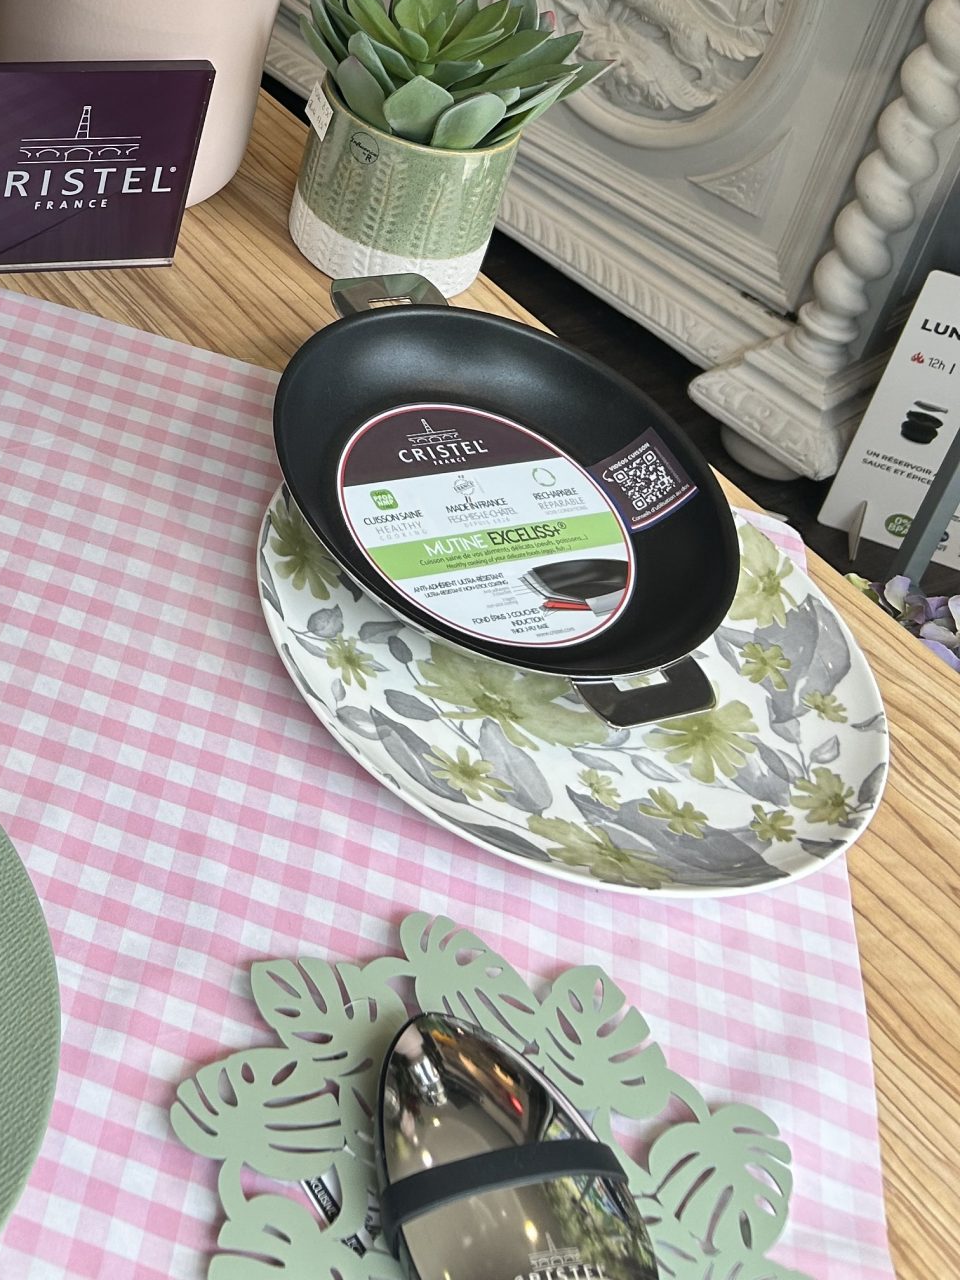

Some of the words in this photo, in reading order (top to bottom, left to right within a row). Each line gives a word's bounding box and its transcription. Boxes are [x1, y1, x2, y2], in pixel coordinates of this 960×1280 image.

[34, 198, 108, 210] FRANCE
[928, 357, 946, 371] 12h
[398, 440, 488, 463] CRISTEL
[433, 456, 467, 466] FRANCE
[861, 458, 894, 473] SAUCE
[893, 468, 906, 477] ET
[866, 449, 880, 458] UN
[881, 454, 932, 476] RÉSERVOIR
[446, 503, 470, 514] MADE
[478, 498, 508, 508] FRANCE
[364, 513, 400, 526] CUISSON
[399, 510, 424, 520] SAINE
[424, 533, 488, 557] MUTINE
